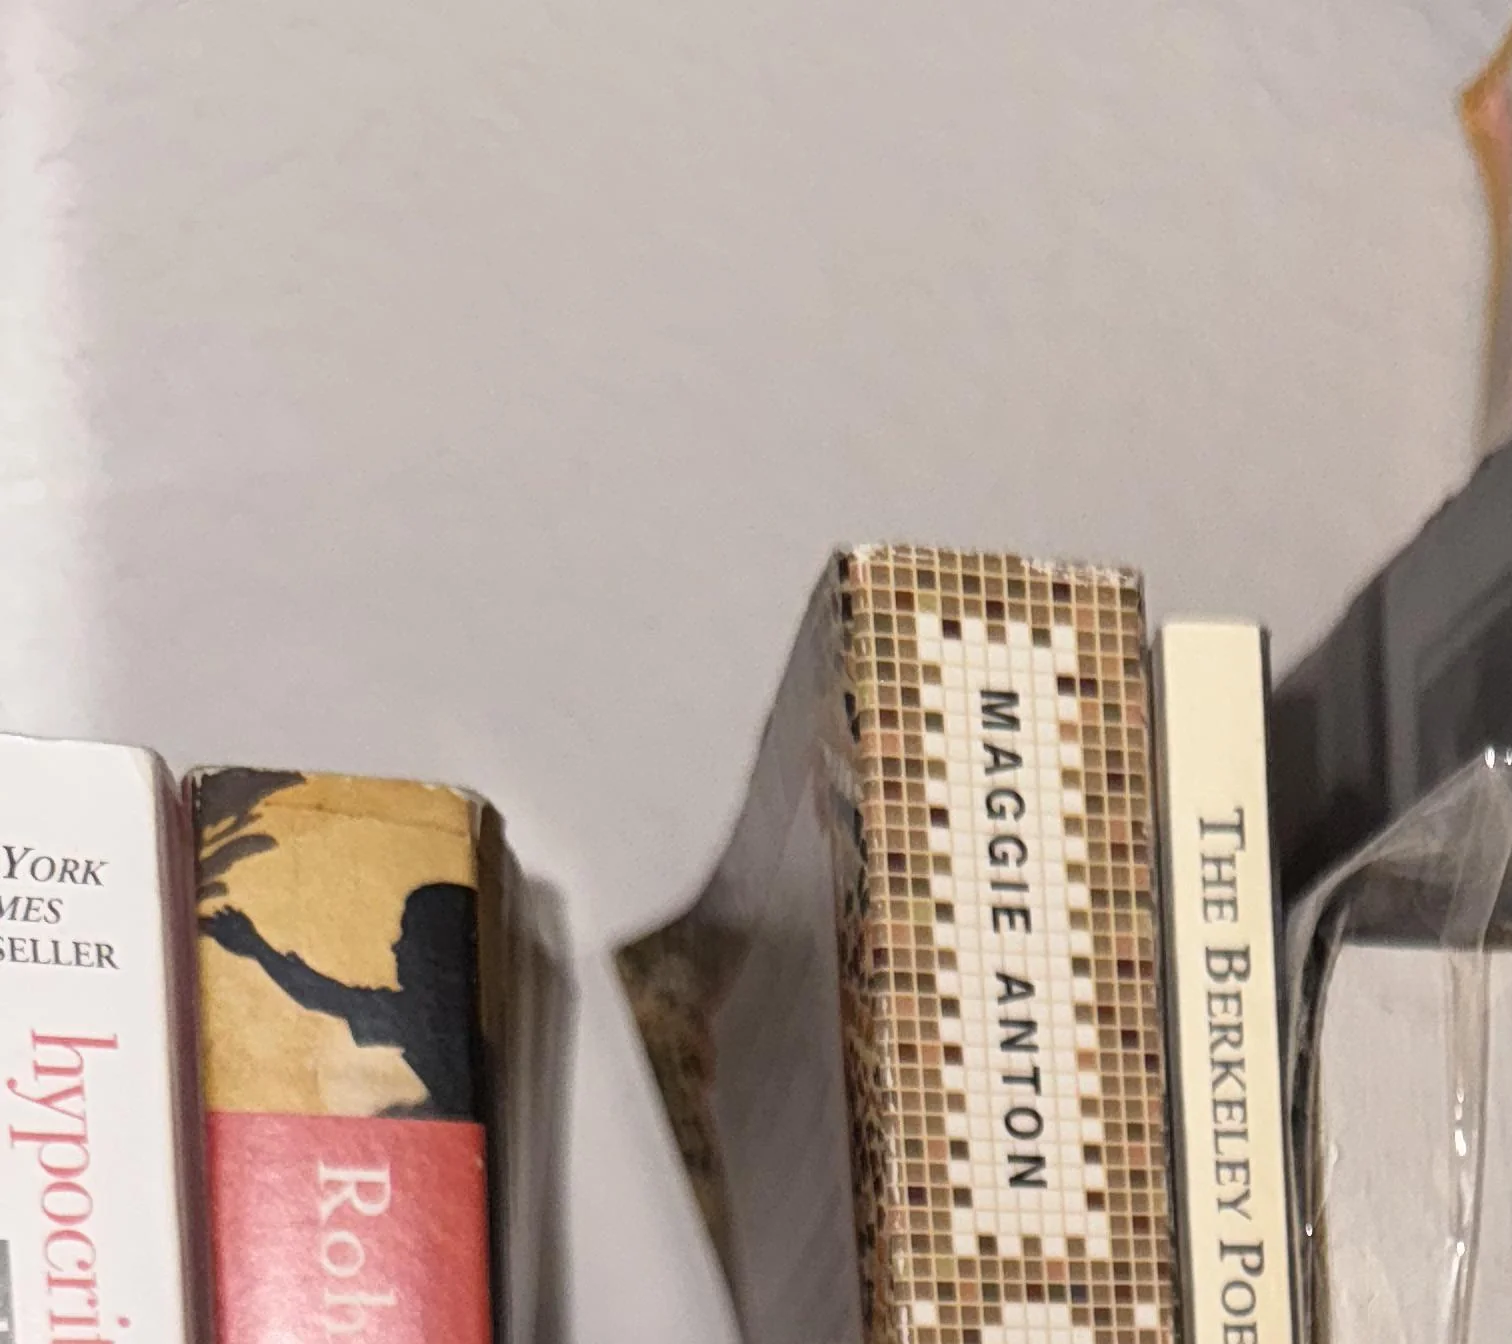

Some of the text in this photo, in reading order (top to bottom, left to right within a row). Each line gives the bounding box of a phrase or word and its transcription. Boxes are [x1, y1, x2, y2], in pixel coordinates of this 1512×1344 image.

[1, 845, 109, 887] YORK
[980, 690, 1048, 1190] MAGGIE ANTON
[1197, 808, 1247, 924] THE
[1204, 944, 1252, 1221] BERKELEY
